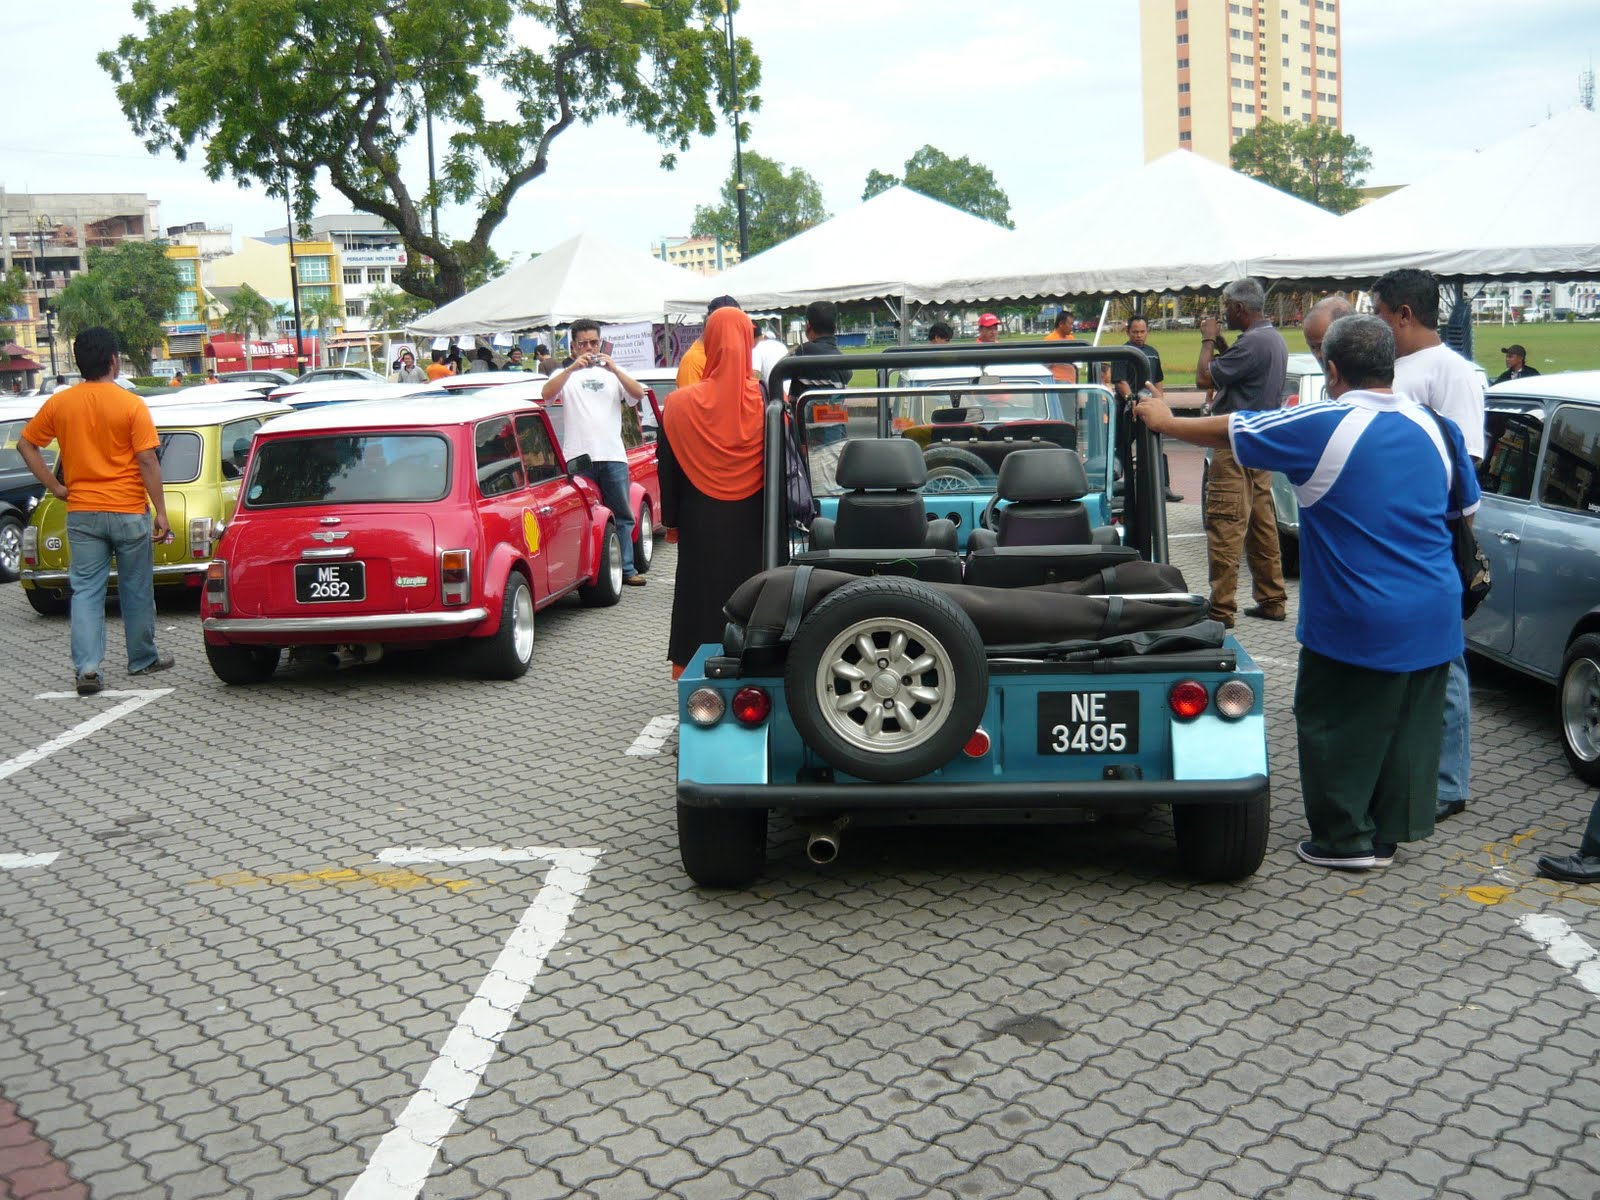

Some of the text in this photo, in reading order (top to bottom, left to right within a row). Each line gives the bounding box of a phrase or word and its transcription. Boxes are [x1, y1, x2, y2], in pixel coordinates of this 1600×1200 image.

[272, 342, 295, 353] TIMES
[47, 539, 60, 548] GB
[318, 566, 340, 582] ME
[310, 582, 350, 598] 2682
[1071, 693, 1107, 722] NE
[1051, 723, 1127, 753] 3495
